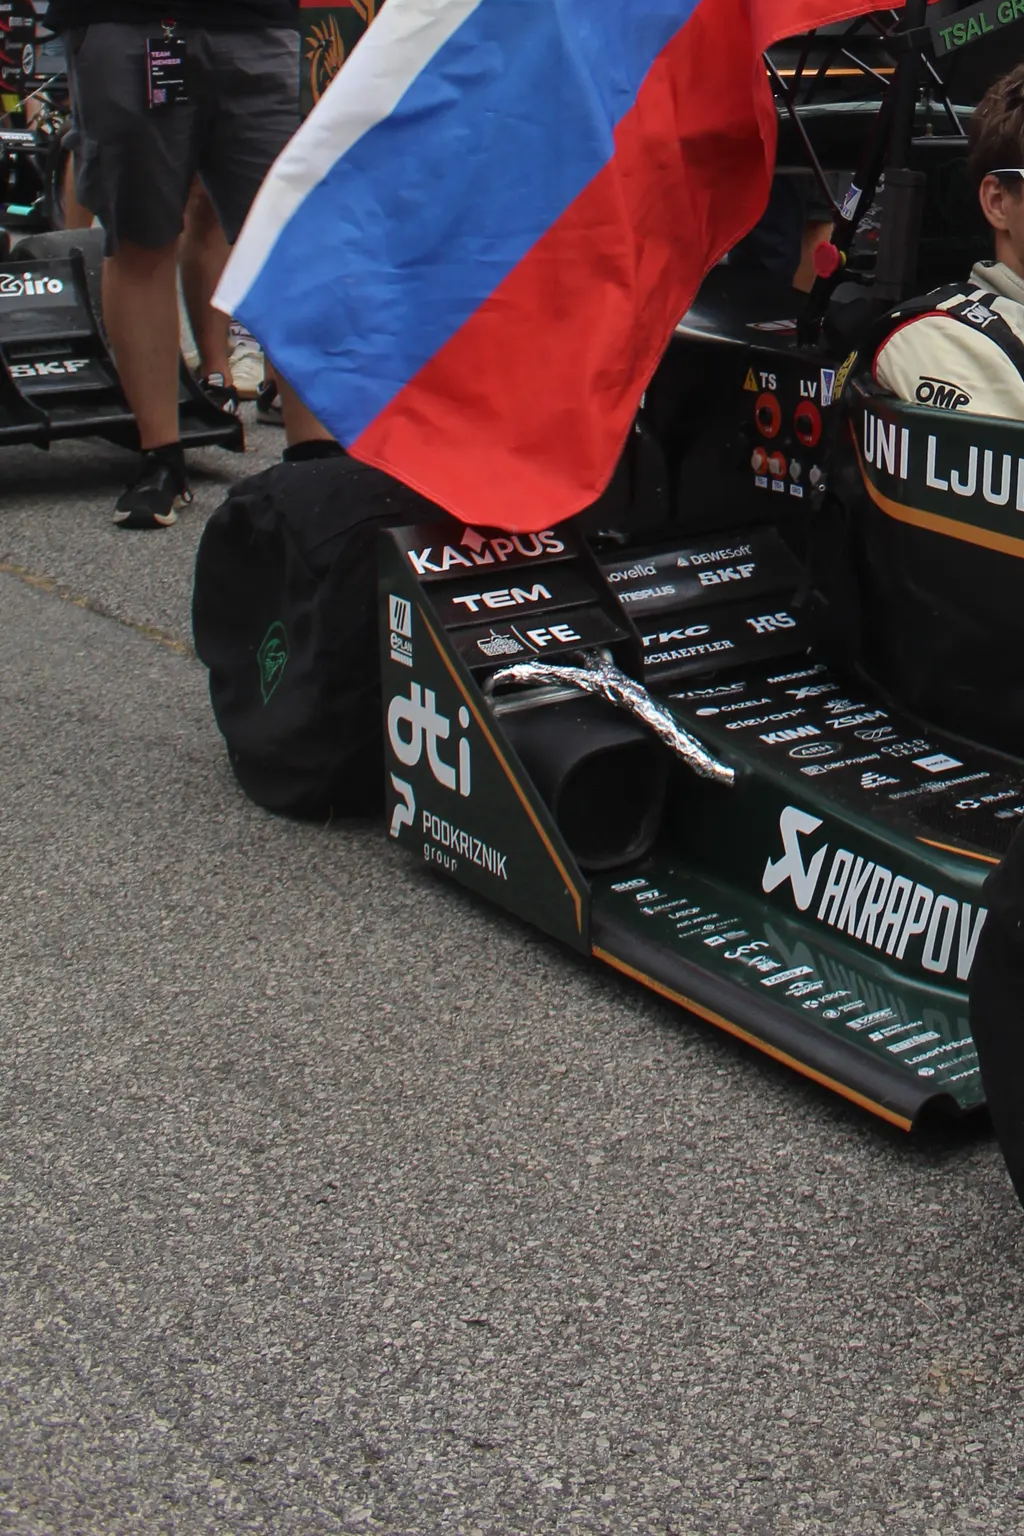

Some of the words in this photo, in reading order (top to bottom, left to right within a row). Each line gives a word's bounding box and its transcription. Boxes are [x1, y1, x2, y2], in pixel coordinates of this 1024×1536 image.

[939, 12, 994, 50] TSAL
[9, 359, 90, 378] SKF
[760, 371, 777, 390] TS
[800, 379, 817, 398] LV
[915, 381, 970, 411] OMP
[864, 409, 909, 480] UNI
[698, 563, 756, 587] SKF
[452, 583, 552, 612] TEM
[526, 623, 582, 647] FE
[720, 697, 773, 712] GAZELA
[825, 709, 889, 729] ZSAM
[388, 681, 471, 798] dti
[759, 724, 822, 745] KIMI
